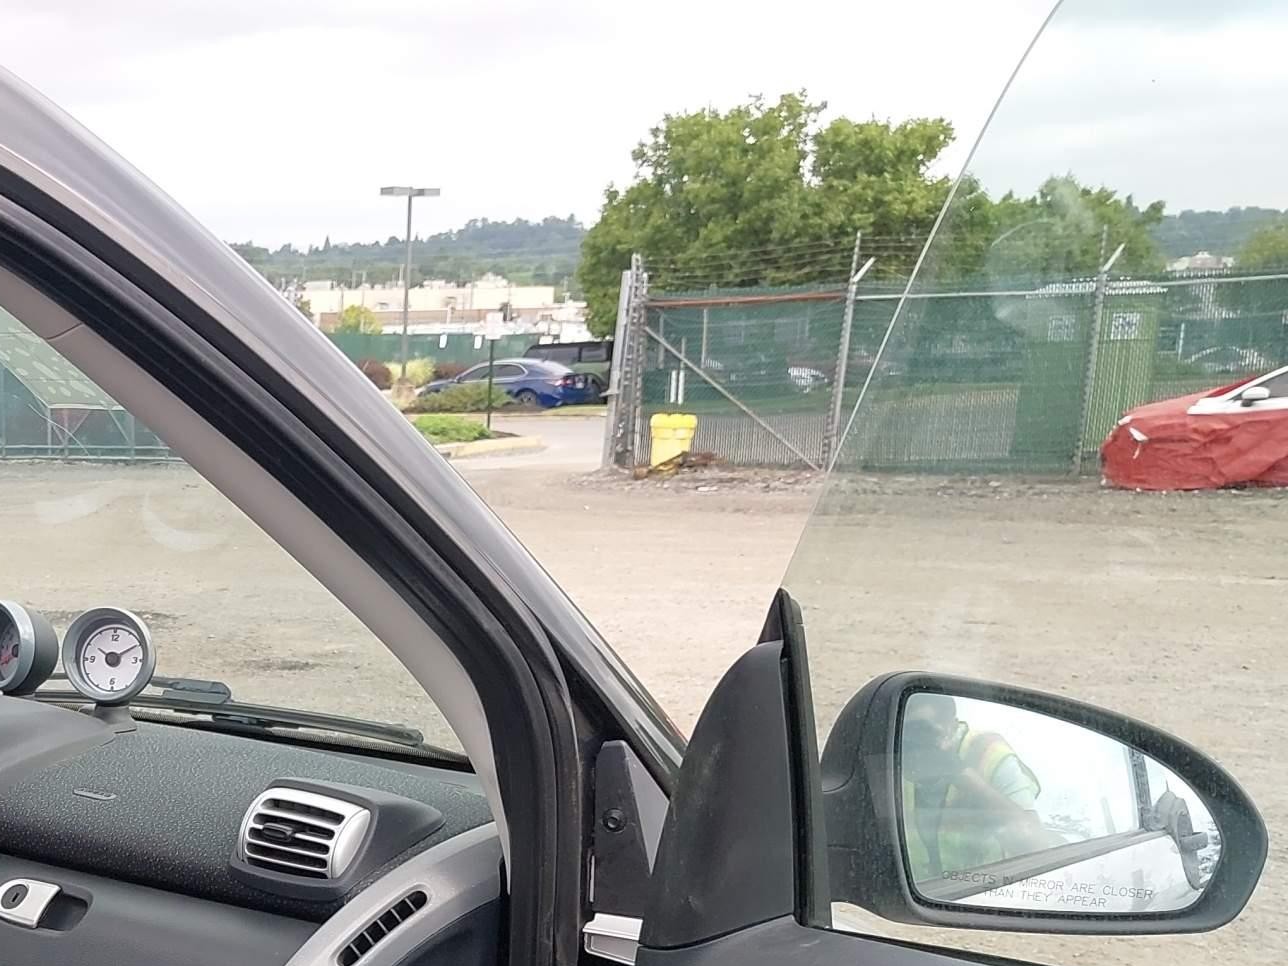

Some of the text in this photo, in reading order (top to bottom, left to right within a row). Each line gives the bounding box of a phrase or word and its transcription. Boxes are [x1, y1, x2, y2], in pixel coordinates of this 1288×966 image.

[111, 634, 120, 642] 12
[89, 655, 96, 663] 9
[131, 656, 138, 664] 3
[109, 677, 116, 685] 6
[942, 870, 1153, 899] OBJECTS IN MIRROR ARE CLOSER
[983, 886, 1107, 907] THAN THEY APPEAR
